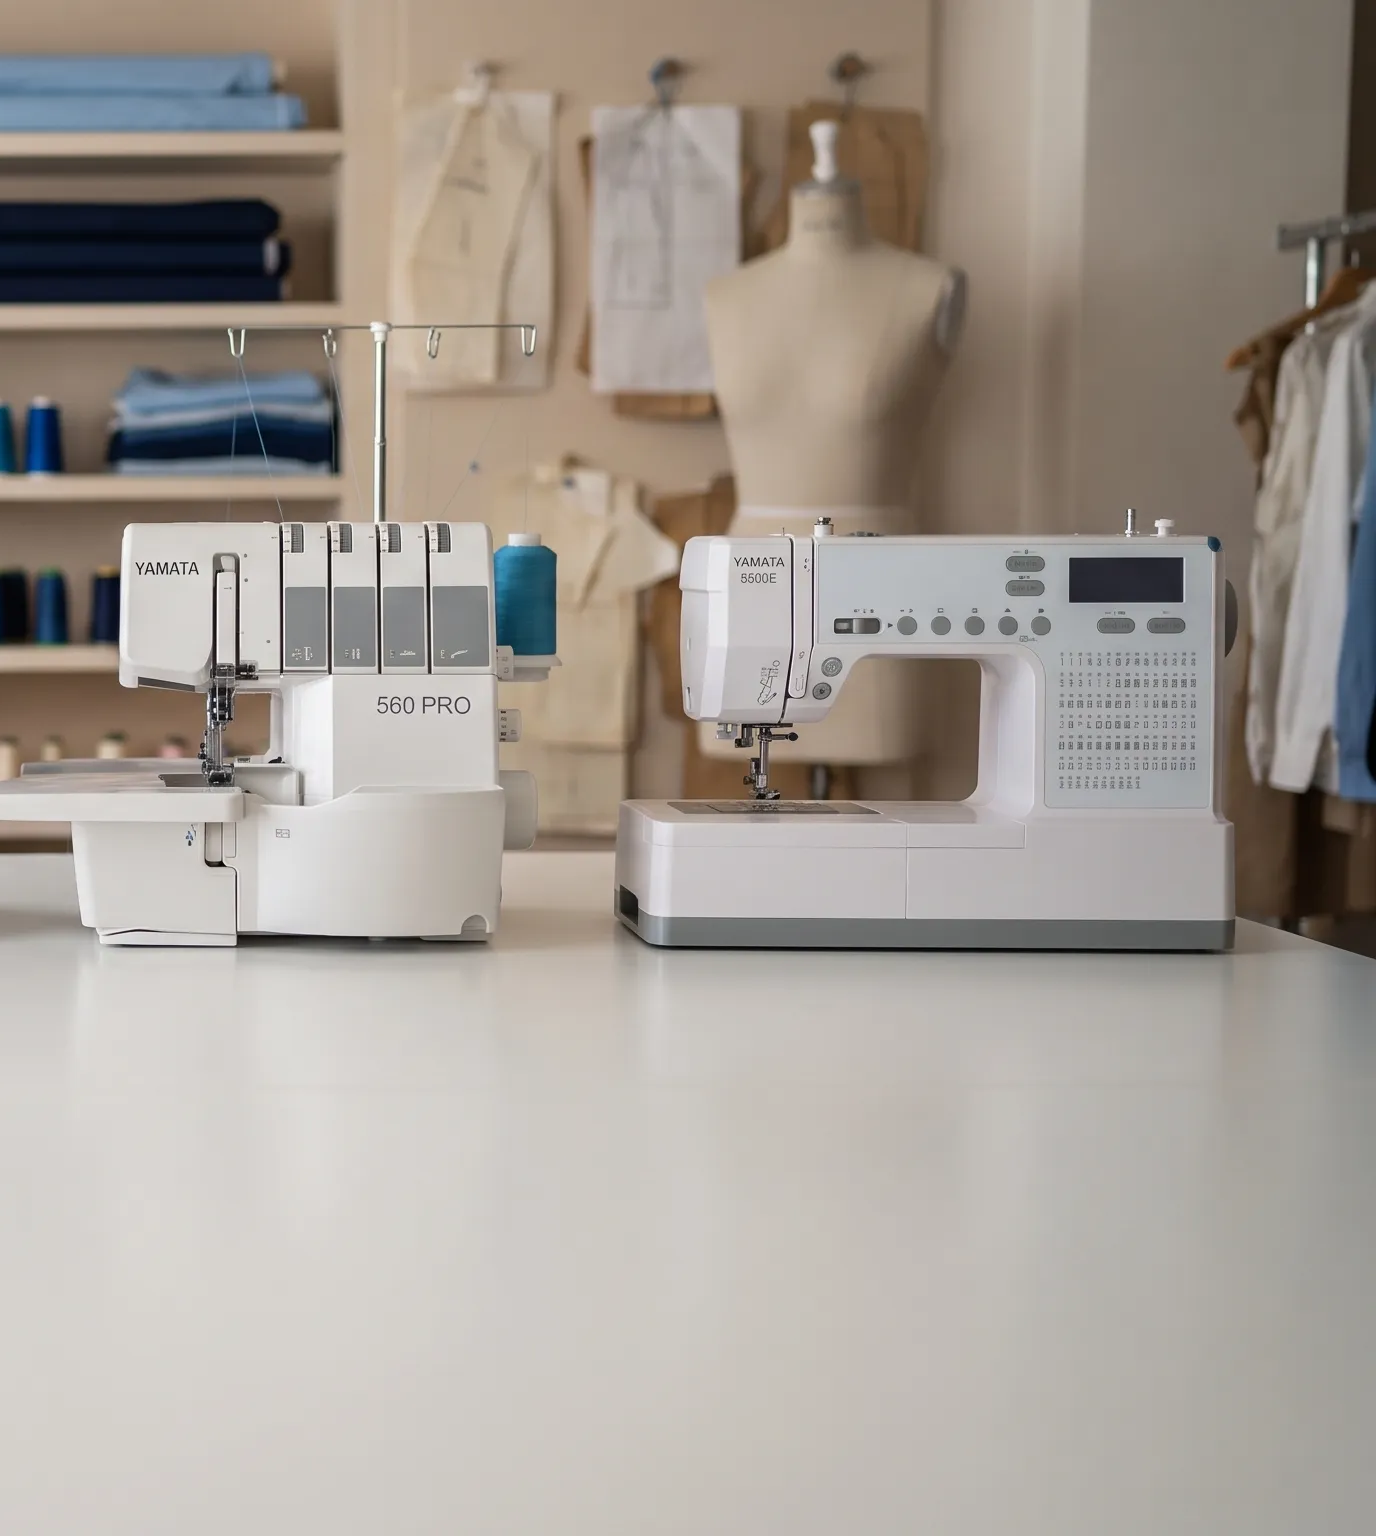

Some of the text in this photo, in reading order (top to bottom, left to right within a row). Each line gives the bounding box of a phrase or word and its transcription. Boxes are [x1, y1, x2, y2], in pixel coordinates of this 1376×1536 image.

[134, 561, 200, 576] YAMATA
[733, 556, 785, 568] YAMATA
[740, 572, 777, 584] 5500E
[376, 695, 471, 715] 560 PRO
